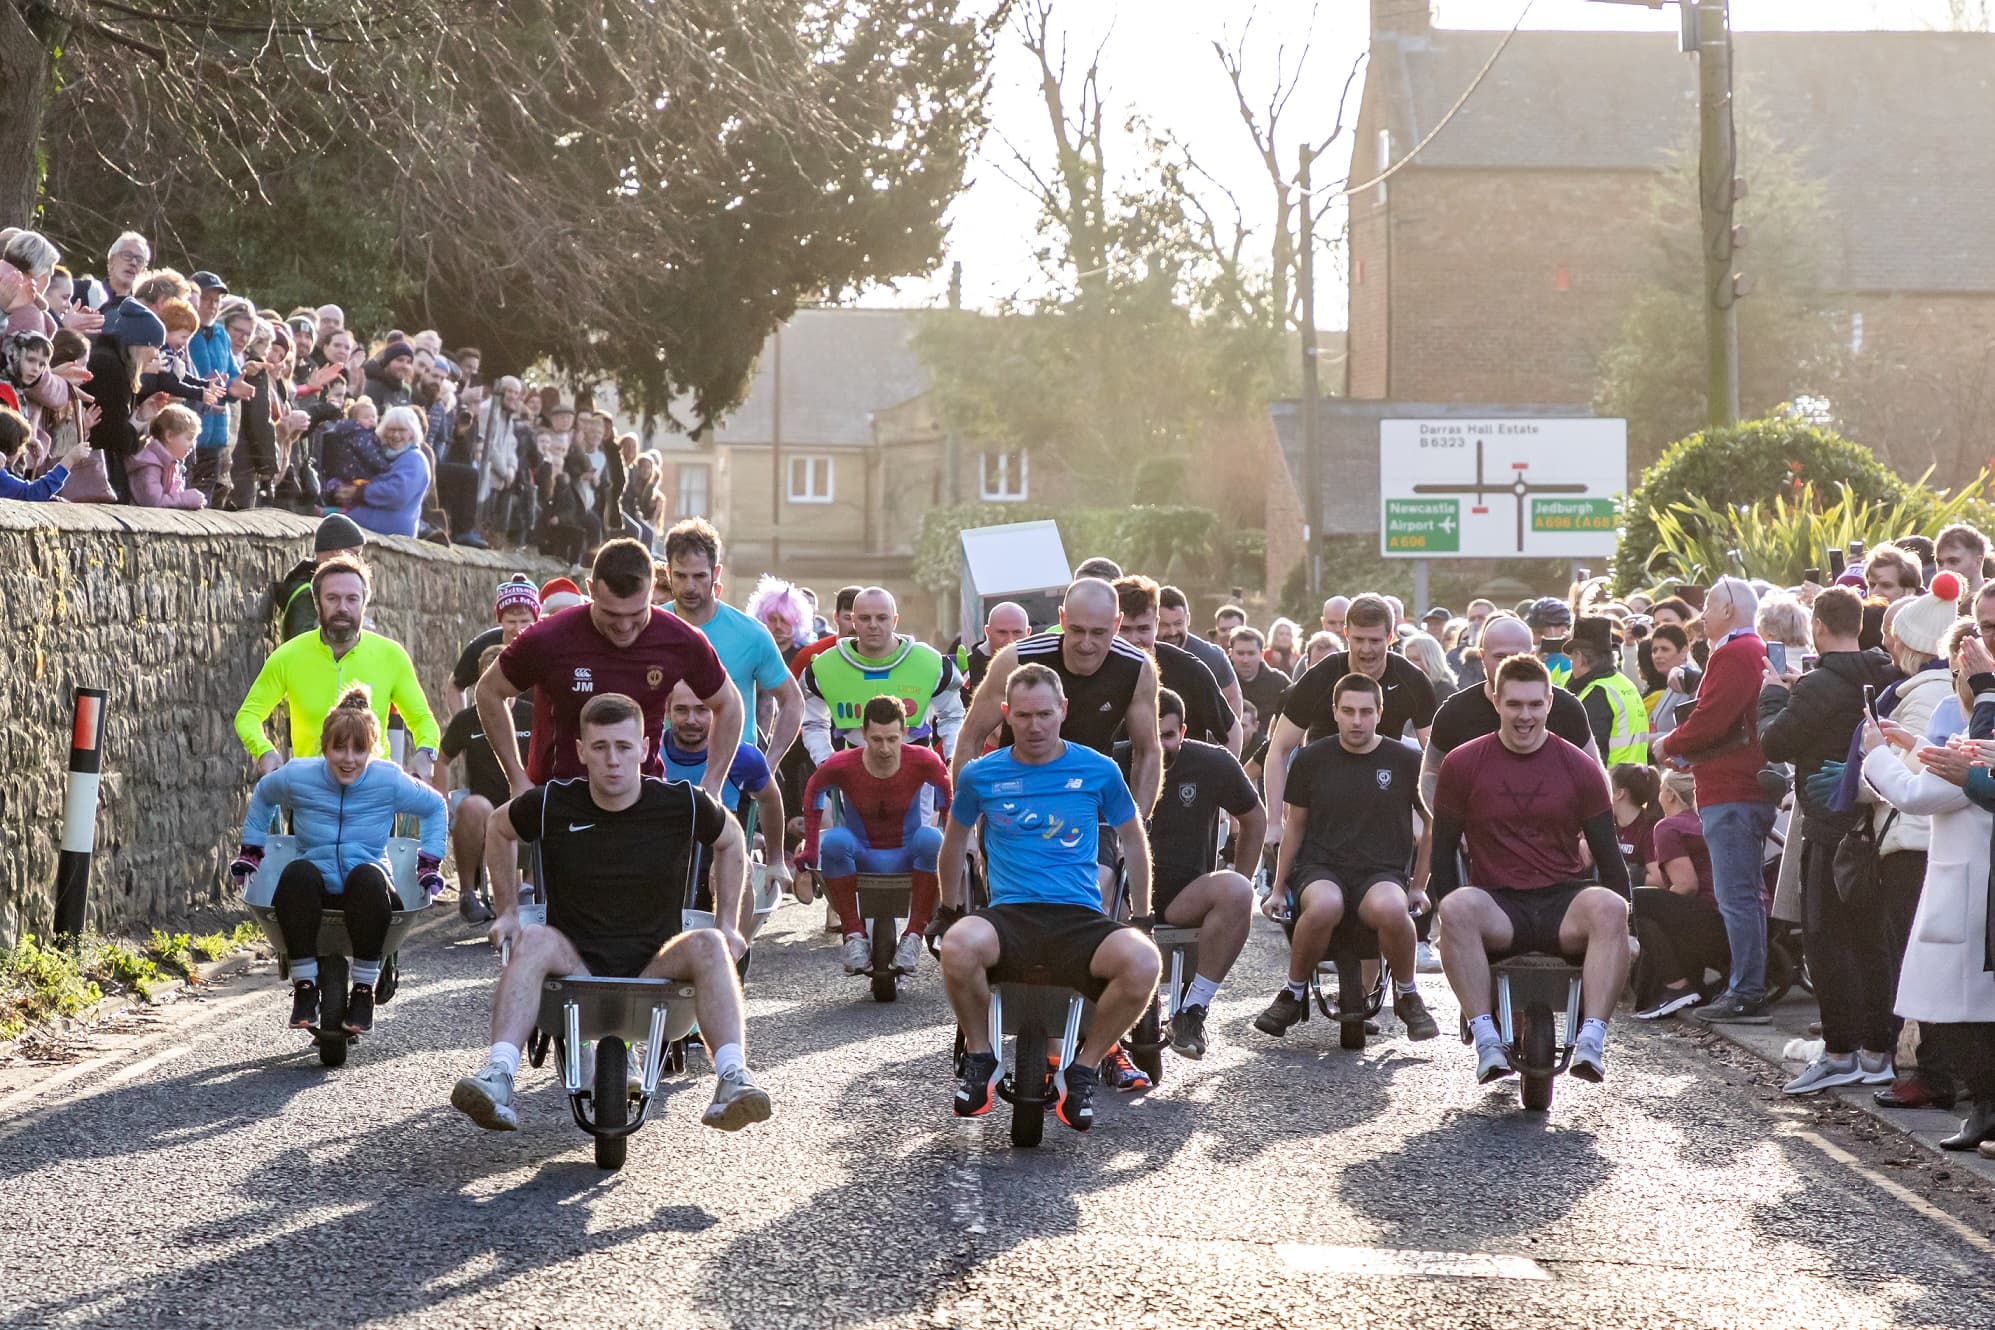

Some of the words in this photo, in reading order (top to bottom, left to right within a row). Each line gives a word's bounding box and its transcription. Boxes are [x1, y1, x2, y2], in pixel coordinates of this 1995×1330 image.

[1420, 424, 1461, 434] Darras
[1467, 424, 1493, 434] Hall
[1498, 424, 1538, 434] Estate
[1389, 502, 1456, 513] Newcastle
[1535, 502, 1593, 516] Jedburgh
[1389, 519, 1434, 532] Airport
[571, 681, 593, 692] JM
